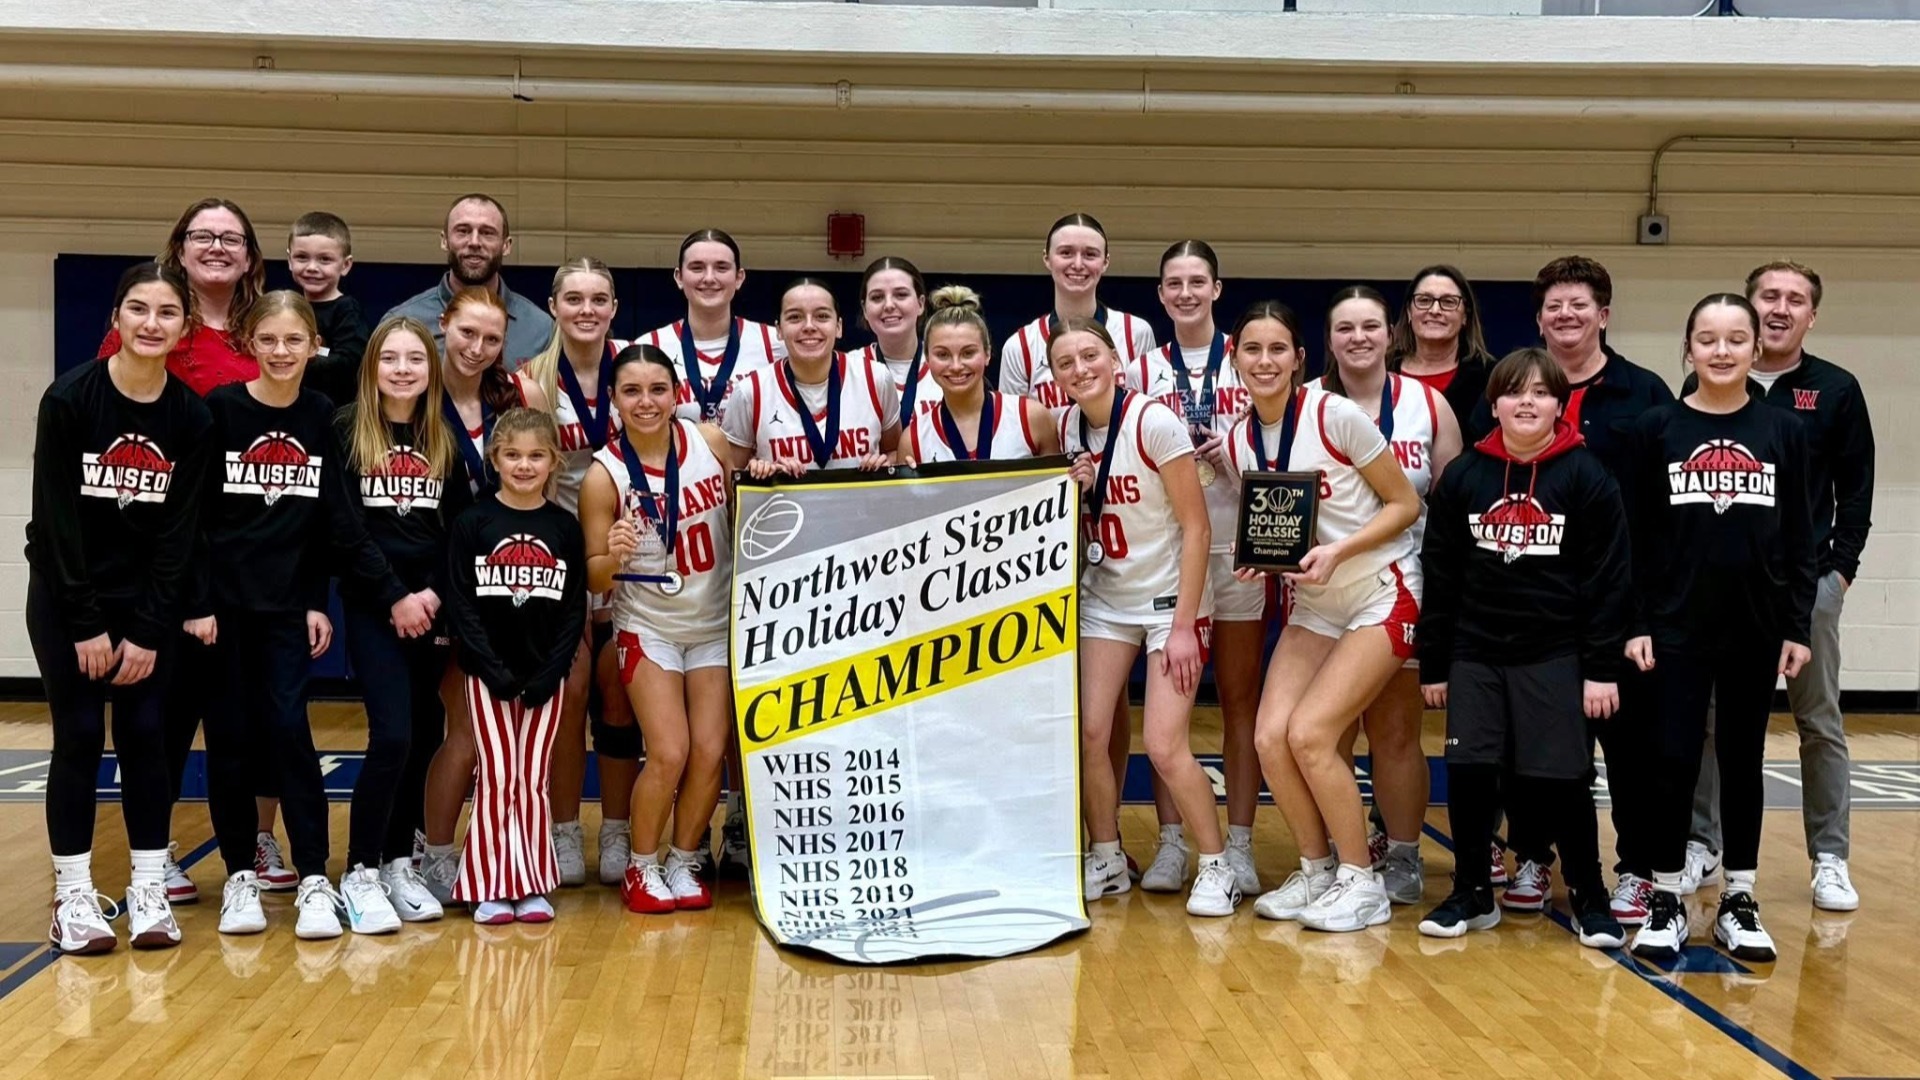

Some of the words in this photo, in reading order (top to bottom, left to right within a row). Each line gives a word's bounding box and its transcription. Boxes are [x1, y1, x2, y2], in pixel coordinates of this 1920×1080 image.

[1793, 388, 1820, 410] W
[768, 427, 870, 464] INDNS
[82, 464, 173, 493] WAUSEO
[225, 462, 321, 487] WAUSEON
[1669, 470, 1775, 496] WAUSEON
[1247, 525, 1301, 538] CLASSIC
[1248, 513, 1303, 527] HOLIDAY
[1469, 523, 1564, 545] WAUSEON
[675, 521, 715, 577] 10
[739, 530, 931, 620] Northwest
[944, 479, 1069, 558] Signal
[1253, 547, 1289, 557] Champion
[475, 565, 567, 591] WAUSEON
[741, 594, 906, 670] Holiday
[919, 535, 1069, 613] Classic
[743, 594, 1072, 744] CHAMPION
[762, 751, 831, 776] WHS
[844, 748, 901, 772] 2014
[773, 779, 832, 802] NHS
[846, 774, 901, 797] 2015
[774, 806, 833, 829] NHS
[848, 801, 905, 825] 2016
[776, 832, 837, 856] NHS
[845, 829, 905, 853] 2017
[780, 860, 840, 884] NHS
[849, 857, 908, 880] 2018
[780, 886, 840, 908] NHS
[850, 884, 914, 905] 2019
[782, 909, 846, 921] NHS
[854, 906, 913, 921] 2021
